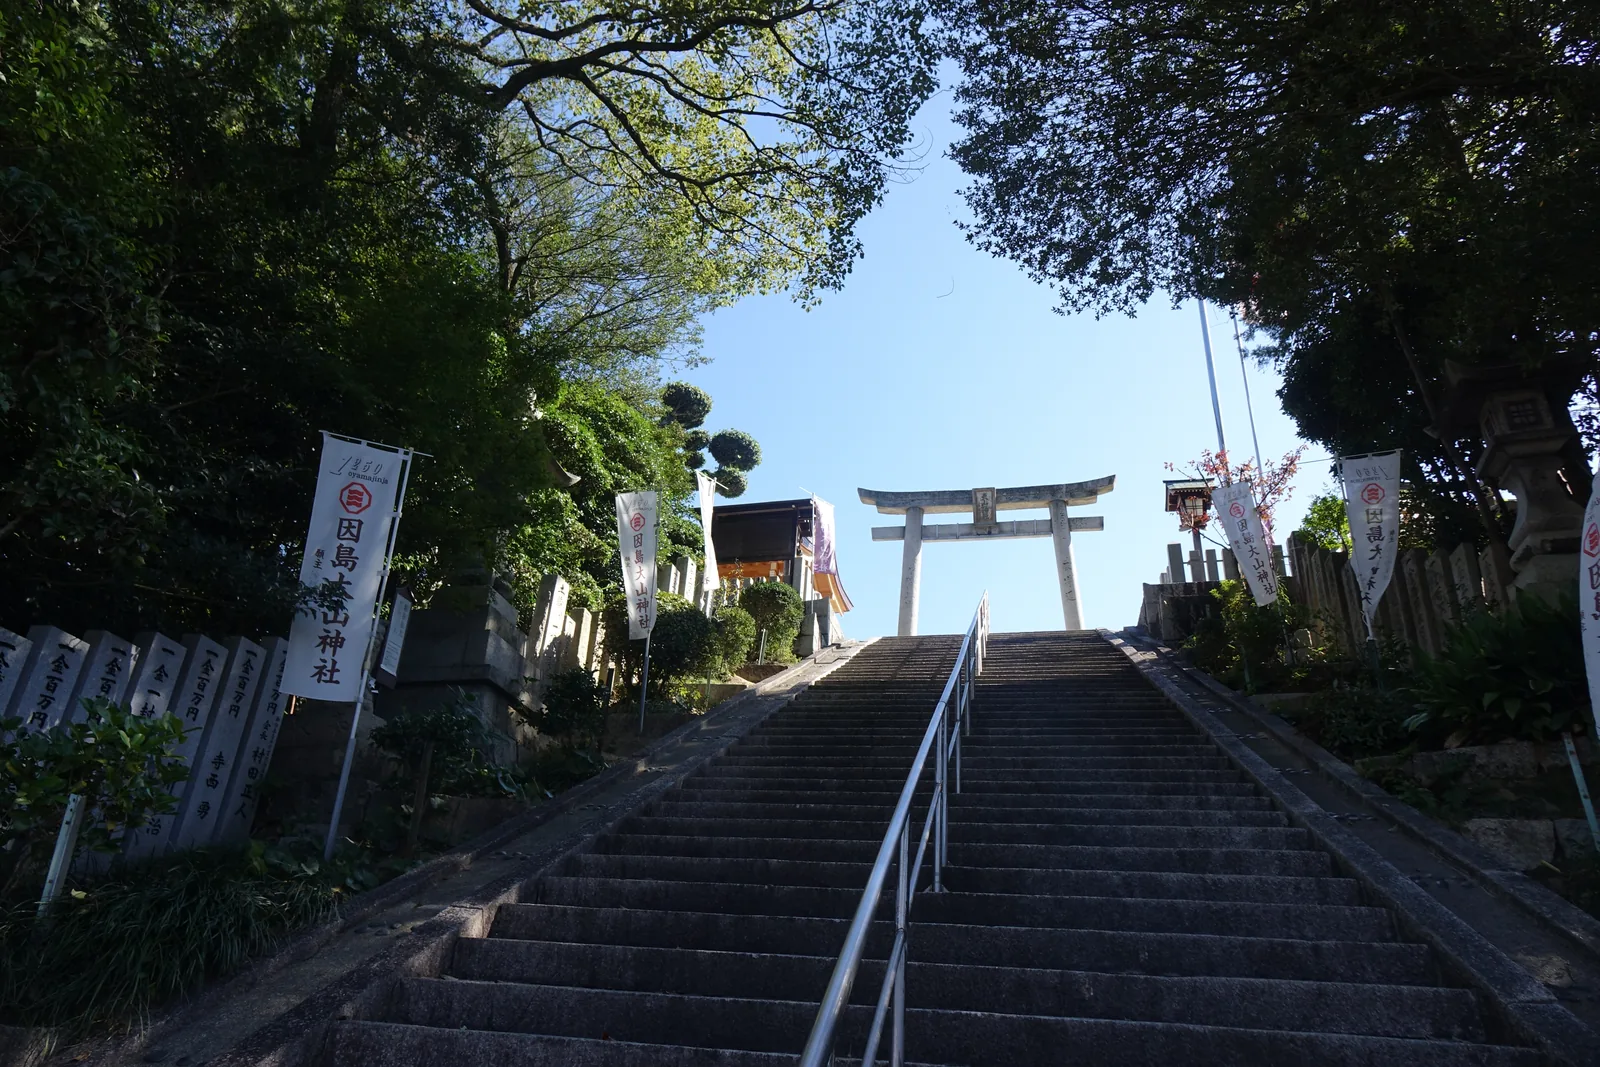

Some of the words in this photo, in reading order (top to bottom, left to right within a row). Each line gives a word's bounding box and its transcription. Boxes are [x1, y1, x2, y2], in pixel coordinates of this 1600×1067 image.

[347, 471, 389, 485] oyamajinja
[632, 533, 651, 629] 因島大山神社
[1235, 518, 1275, 596] 因島大山神社
[310, 517, 364, 685] 因島大山神社
[30, 643, 76, 729] 一金百万円
[139, 647, 175, 718] 一金一封
[185, 649, 218, 722] 一金百万円
[228, 649, 258, 719] 一金百万円
